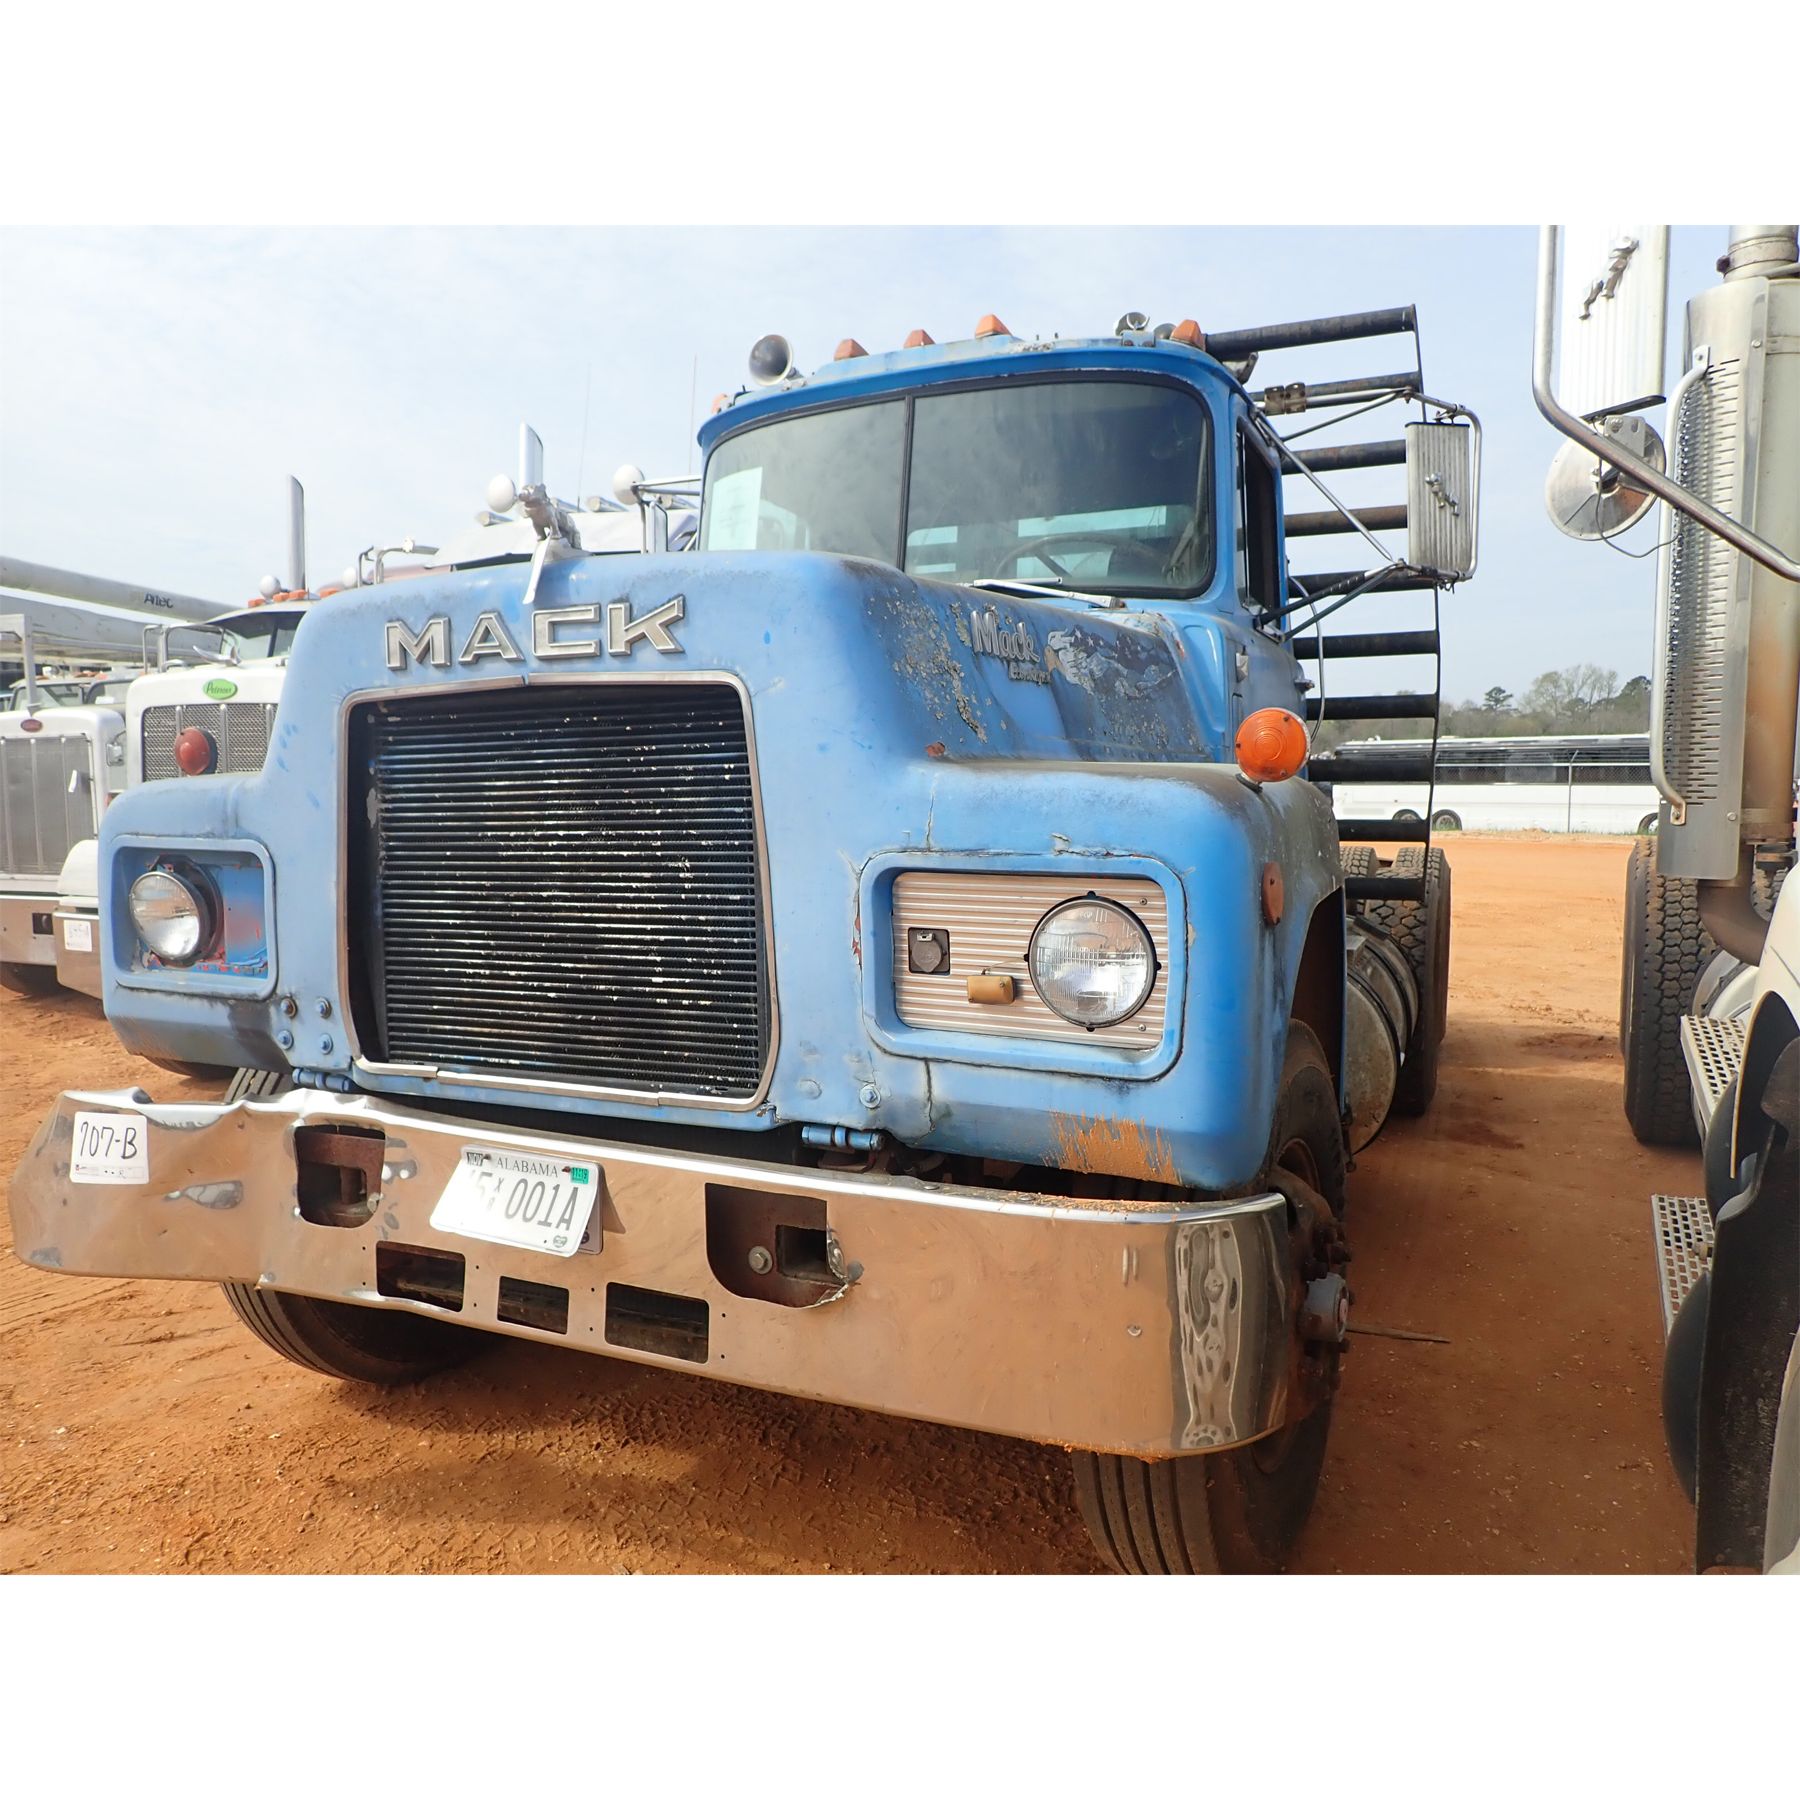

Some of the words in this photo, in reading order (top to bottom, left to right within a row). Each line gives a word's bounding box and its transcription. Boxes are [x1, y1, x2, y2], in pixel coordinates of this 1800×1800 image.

[384, 594, 685, 671] MACK
[970, 609, 1040, 663] Mack
[495, 1157, 559, 1178] ALABAMA
[505, 1177, 579, 1231] 001A
